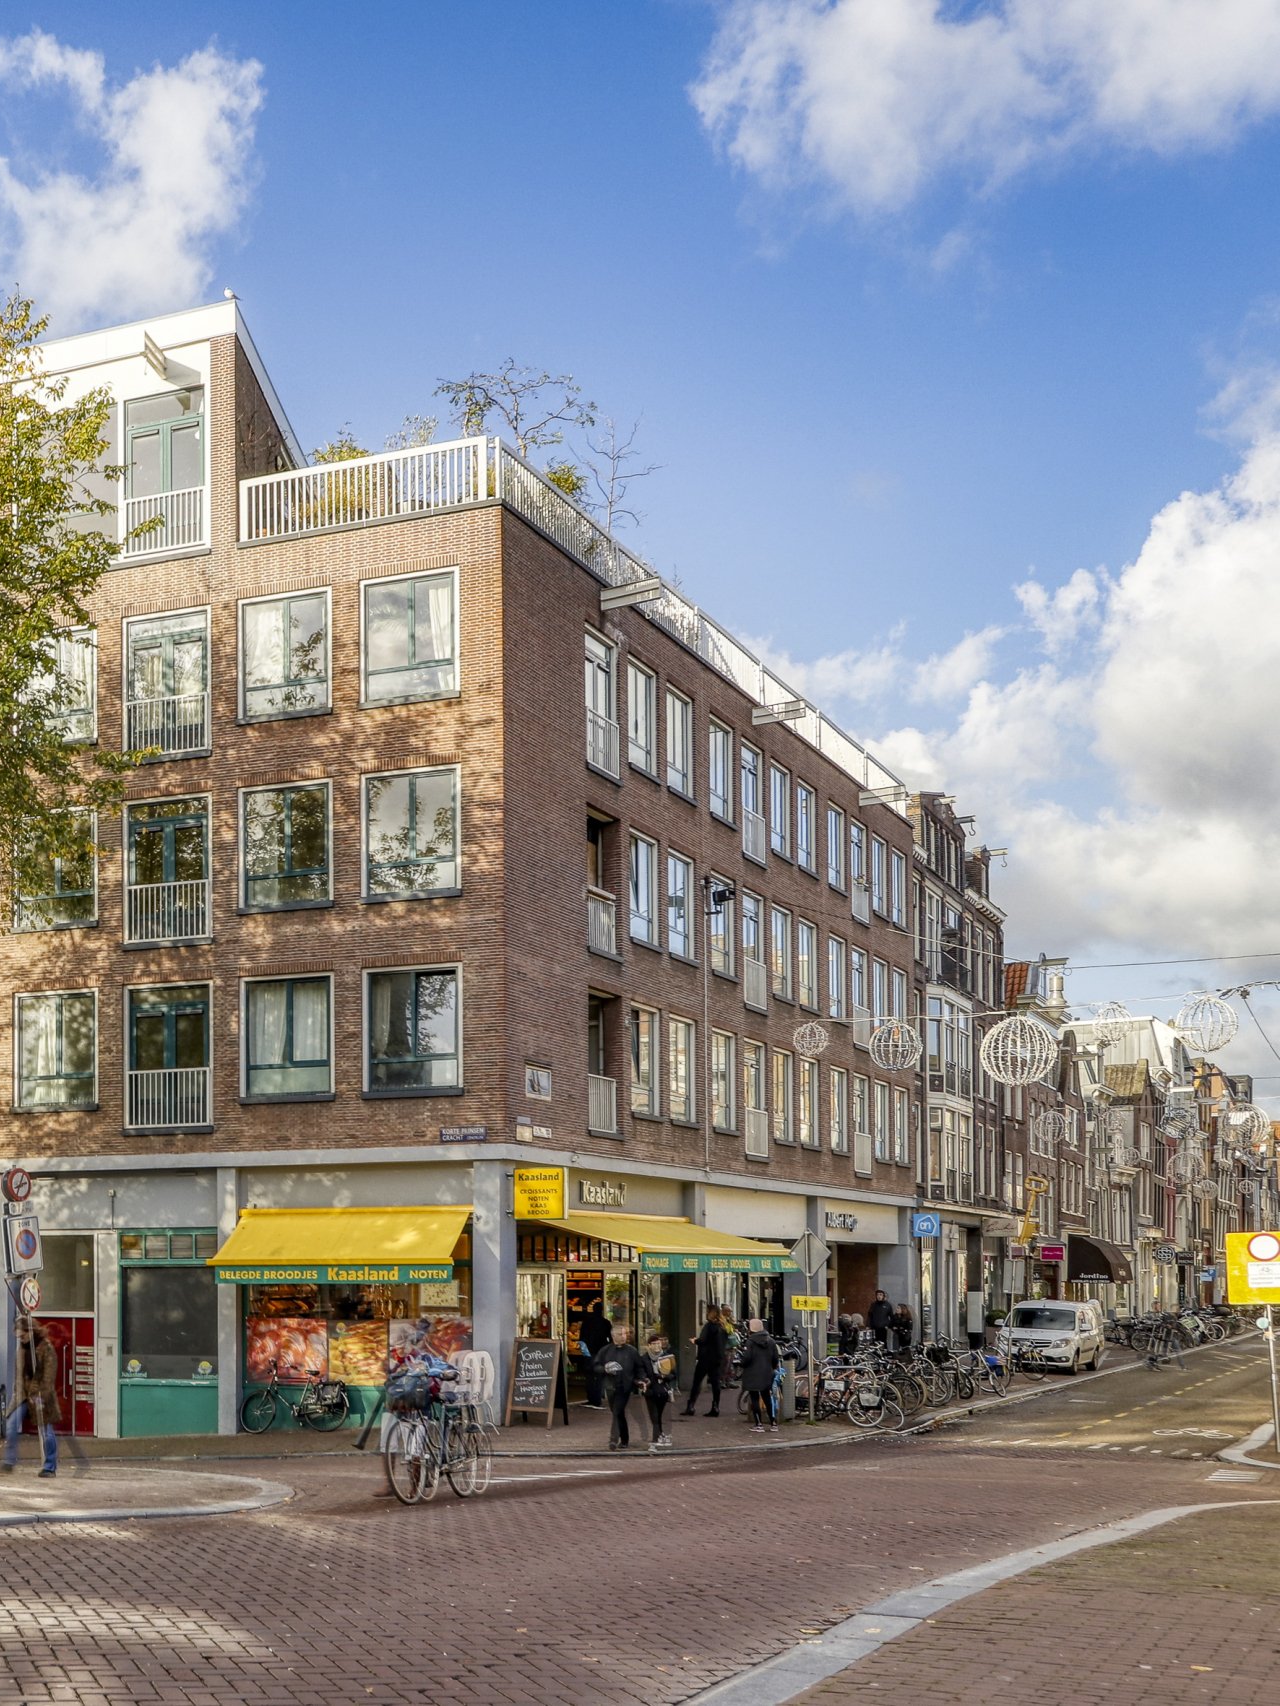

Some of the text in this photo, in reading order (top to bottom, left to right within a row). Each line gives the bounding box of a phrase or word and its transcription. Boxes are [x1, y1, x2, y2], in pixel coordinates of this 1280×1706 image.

[518, 1173, 559, 1181] Kaasland
[580, 1180, 627, 1206] Kaasland
[646, 1257, 669, 1268] FROMAGE
[683, 1258, 699, 1268] CHEESE
[220, 1266, 448, 1281] BELEGDE BROODJES Kaasland NOTEN
